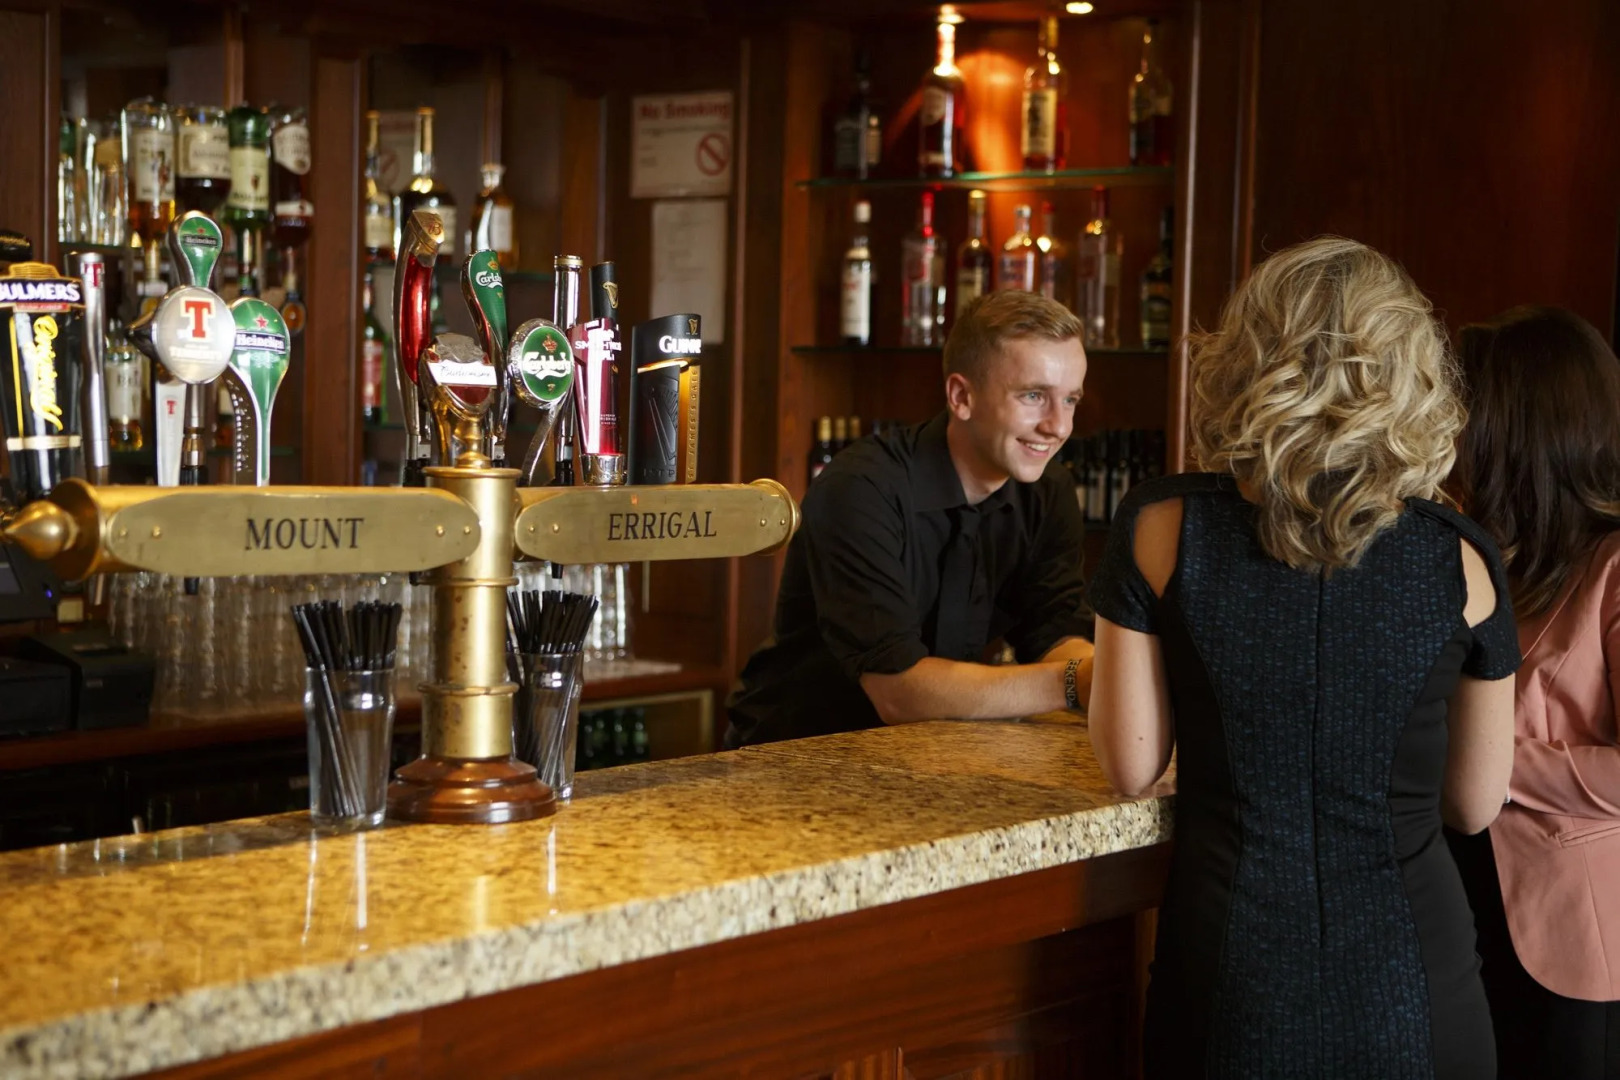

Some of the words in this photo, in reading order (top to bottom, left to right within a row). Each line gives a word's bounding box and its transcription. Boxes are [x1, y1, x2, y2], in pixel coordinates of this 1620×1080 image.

[184, 300, 212, 339] T
[245, 517, 365, 551] MOUNT
[607, 510, 717, 541] ERRIGAL
